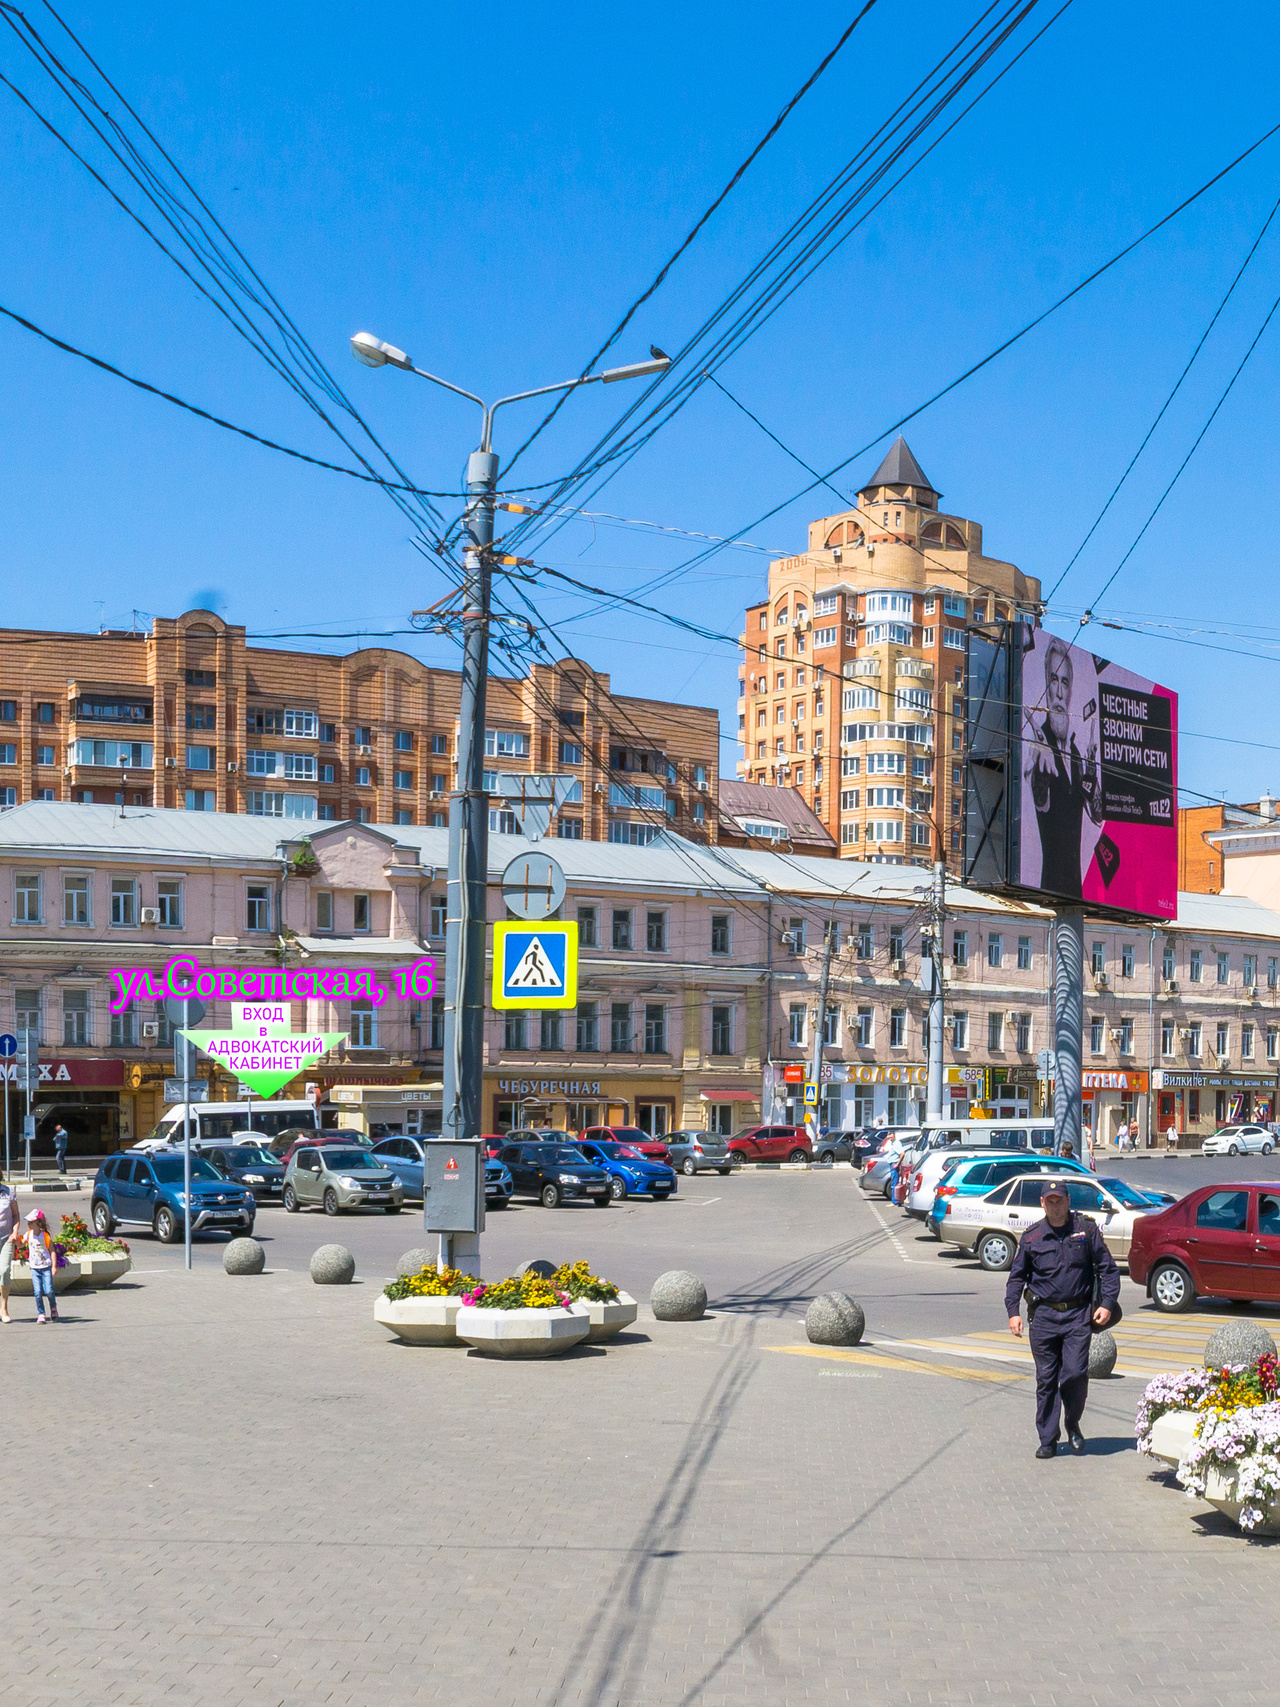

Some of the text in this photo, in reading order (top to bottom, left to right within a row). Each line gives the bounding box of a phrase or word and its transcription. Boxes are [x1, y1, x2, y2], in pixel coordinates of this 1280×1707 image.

[1102, 694, 1148, 720] ЧЕСТНЫЕ
[1103, 718, 1143, 742] ЗВОНКИ
[1104, 741, 1168, 769] ВНУТРИ СЕТИ
[1149, 798, 1171, 818] TELE2
[1099, 842, 1113, 867] TELE2
[821, 1065, 832, 1078] 85
[846, 1065, 928, 1083] ЗОЛОТО
[1082, 1072, 1128, 1089] ПТЕКА
[401, 1092, 431, 1101] ЦВЕТЫ
[498, 1080, 600, 1094] ЧЕБУРЕЧНАЯ
